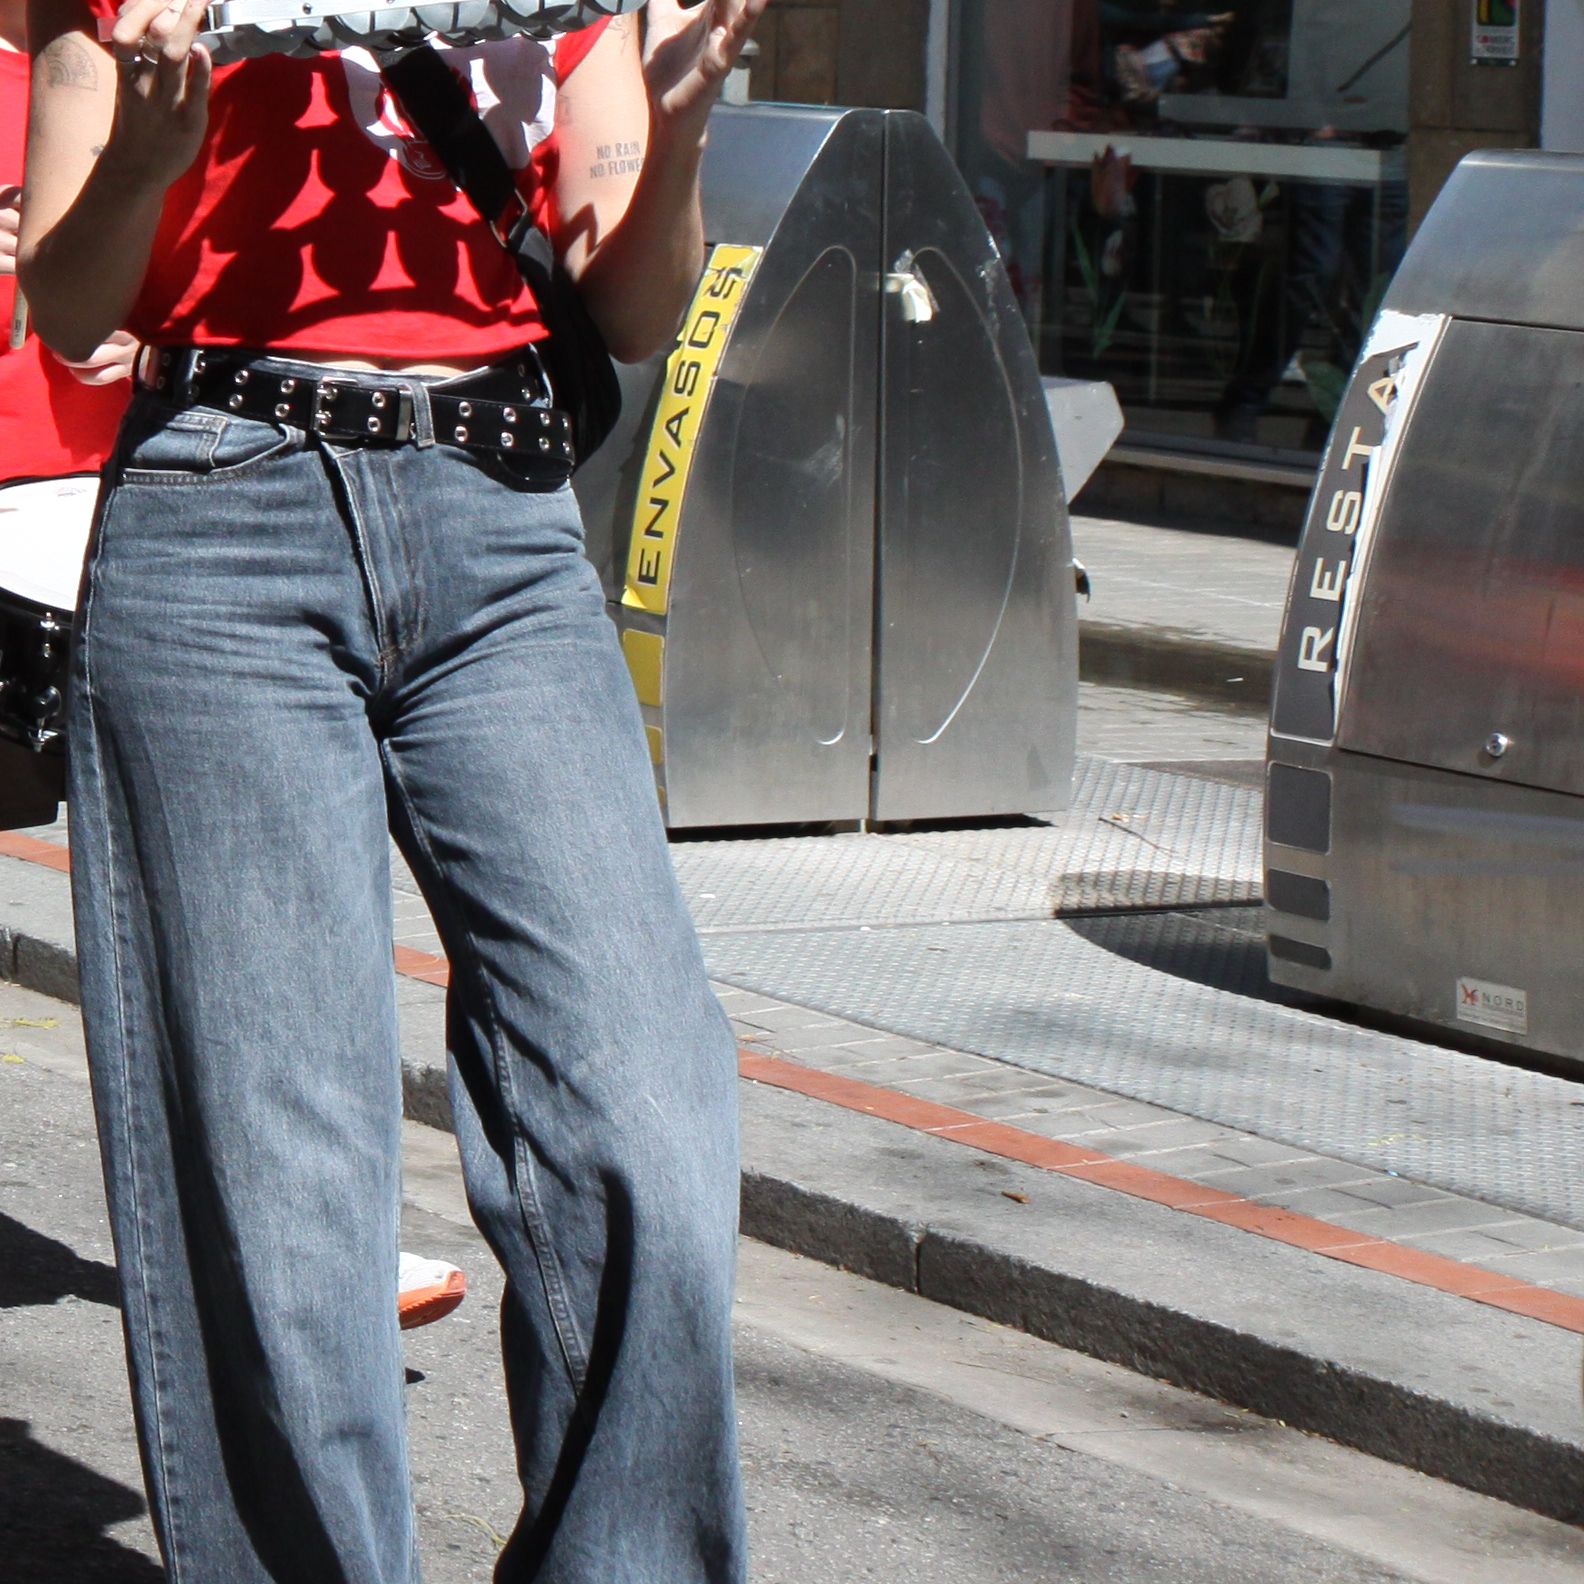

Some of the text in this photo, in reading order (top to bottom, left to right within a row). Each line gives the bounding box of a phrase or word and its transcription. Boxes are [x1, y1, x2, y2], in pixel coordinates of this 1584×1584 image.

[590, 163, 606, 179] NO
[596, 144, 612, 160] NO
[637, 265, 744, 586] ENVASOS
[1297, 376, 1398, 673] RESTA
